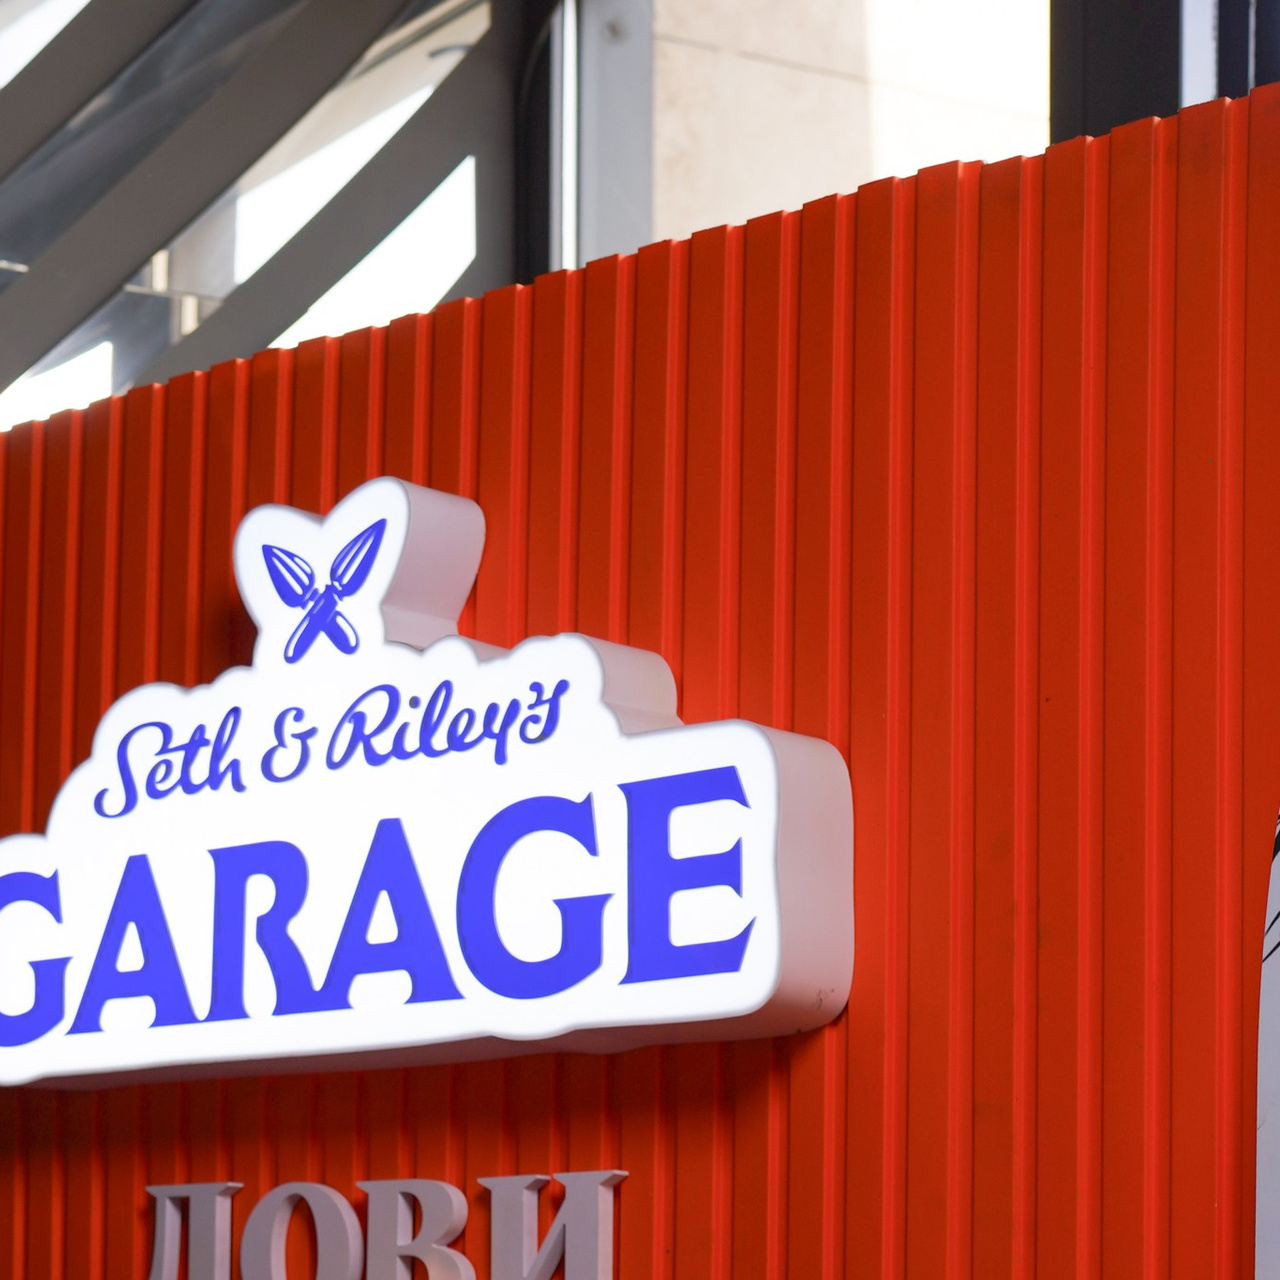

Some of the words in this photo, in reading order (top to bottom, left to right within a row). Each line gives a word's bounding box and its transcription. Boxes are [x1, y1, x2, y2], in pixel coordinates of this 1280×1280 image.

[93, 706, 247, 819] Seth
[260, 706, 319, 784] &
[325, 678, 571, 771] Riley's
